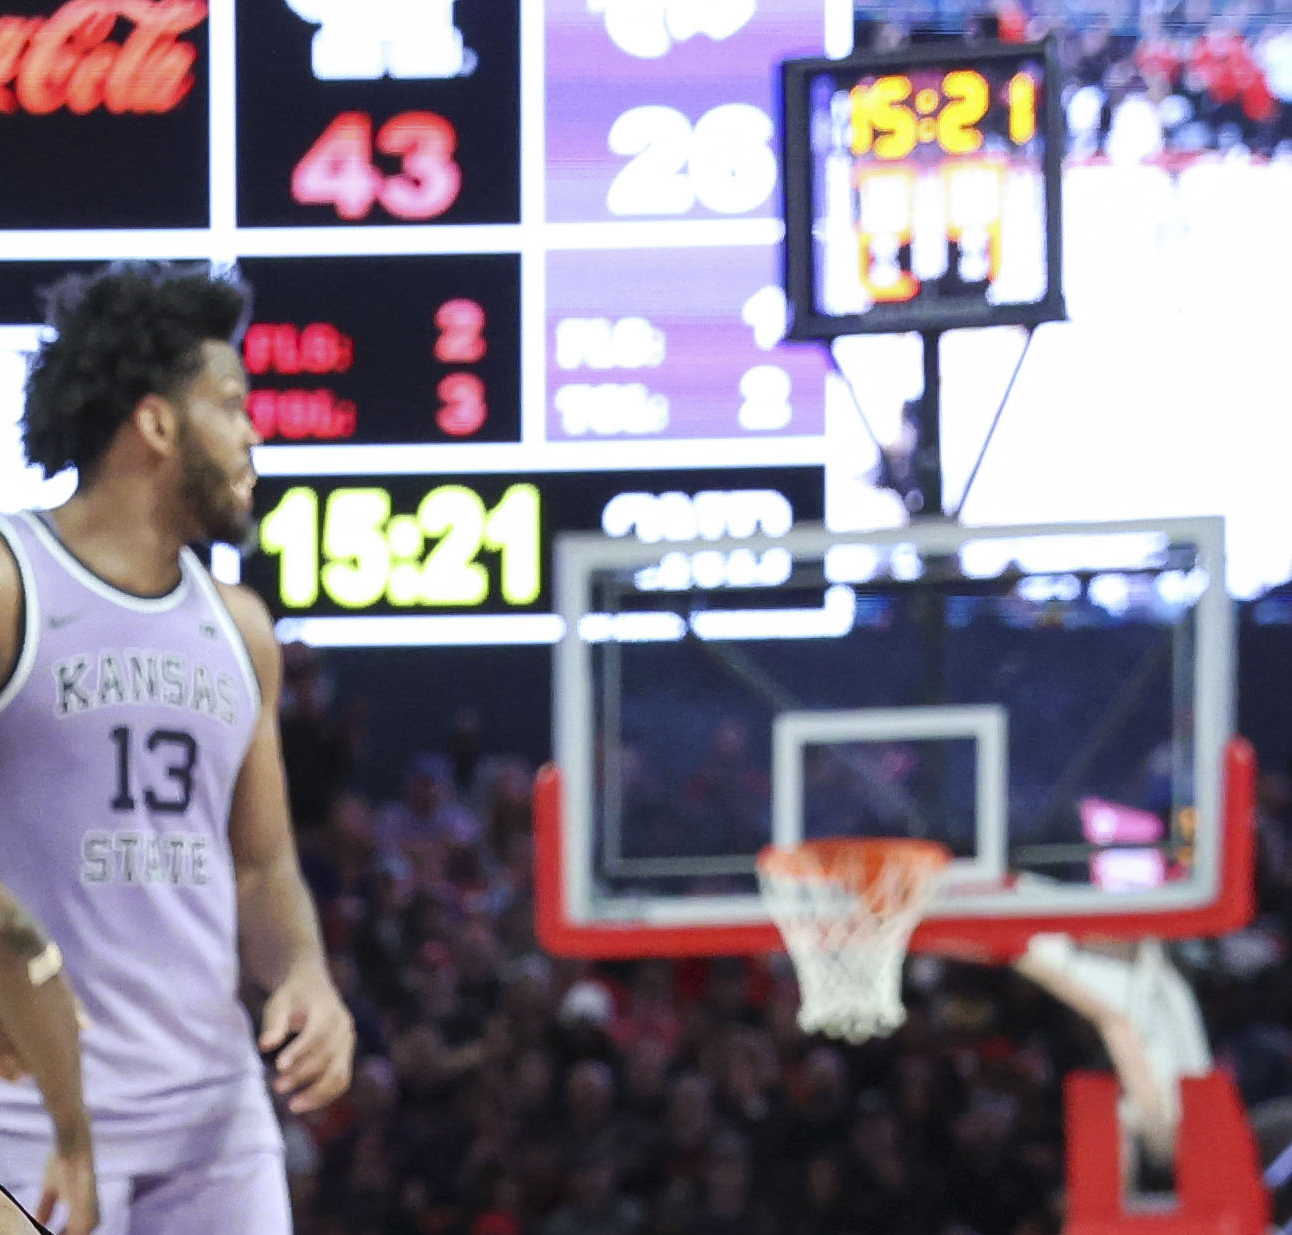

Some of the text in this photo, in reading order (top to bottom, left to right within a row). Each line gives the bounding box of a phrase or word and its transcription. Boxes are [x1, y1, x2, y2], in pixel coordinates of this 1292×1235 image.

[291, 109, 462, 221] 43
[606, 104, 776, 215] 26
[434, 297, 487, 364] 2
[436, 371, 488, 436] 3
[260, 484, 541, 606] 15:21
[108, 724, 198, 814] 13
[80, 830, 212, 886] STATE
